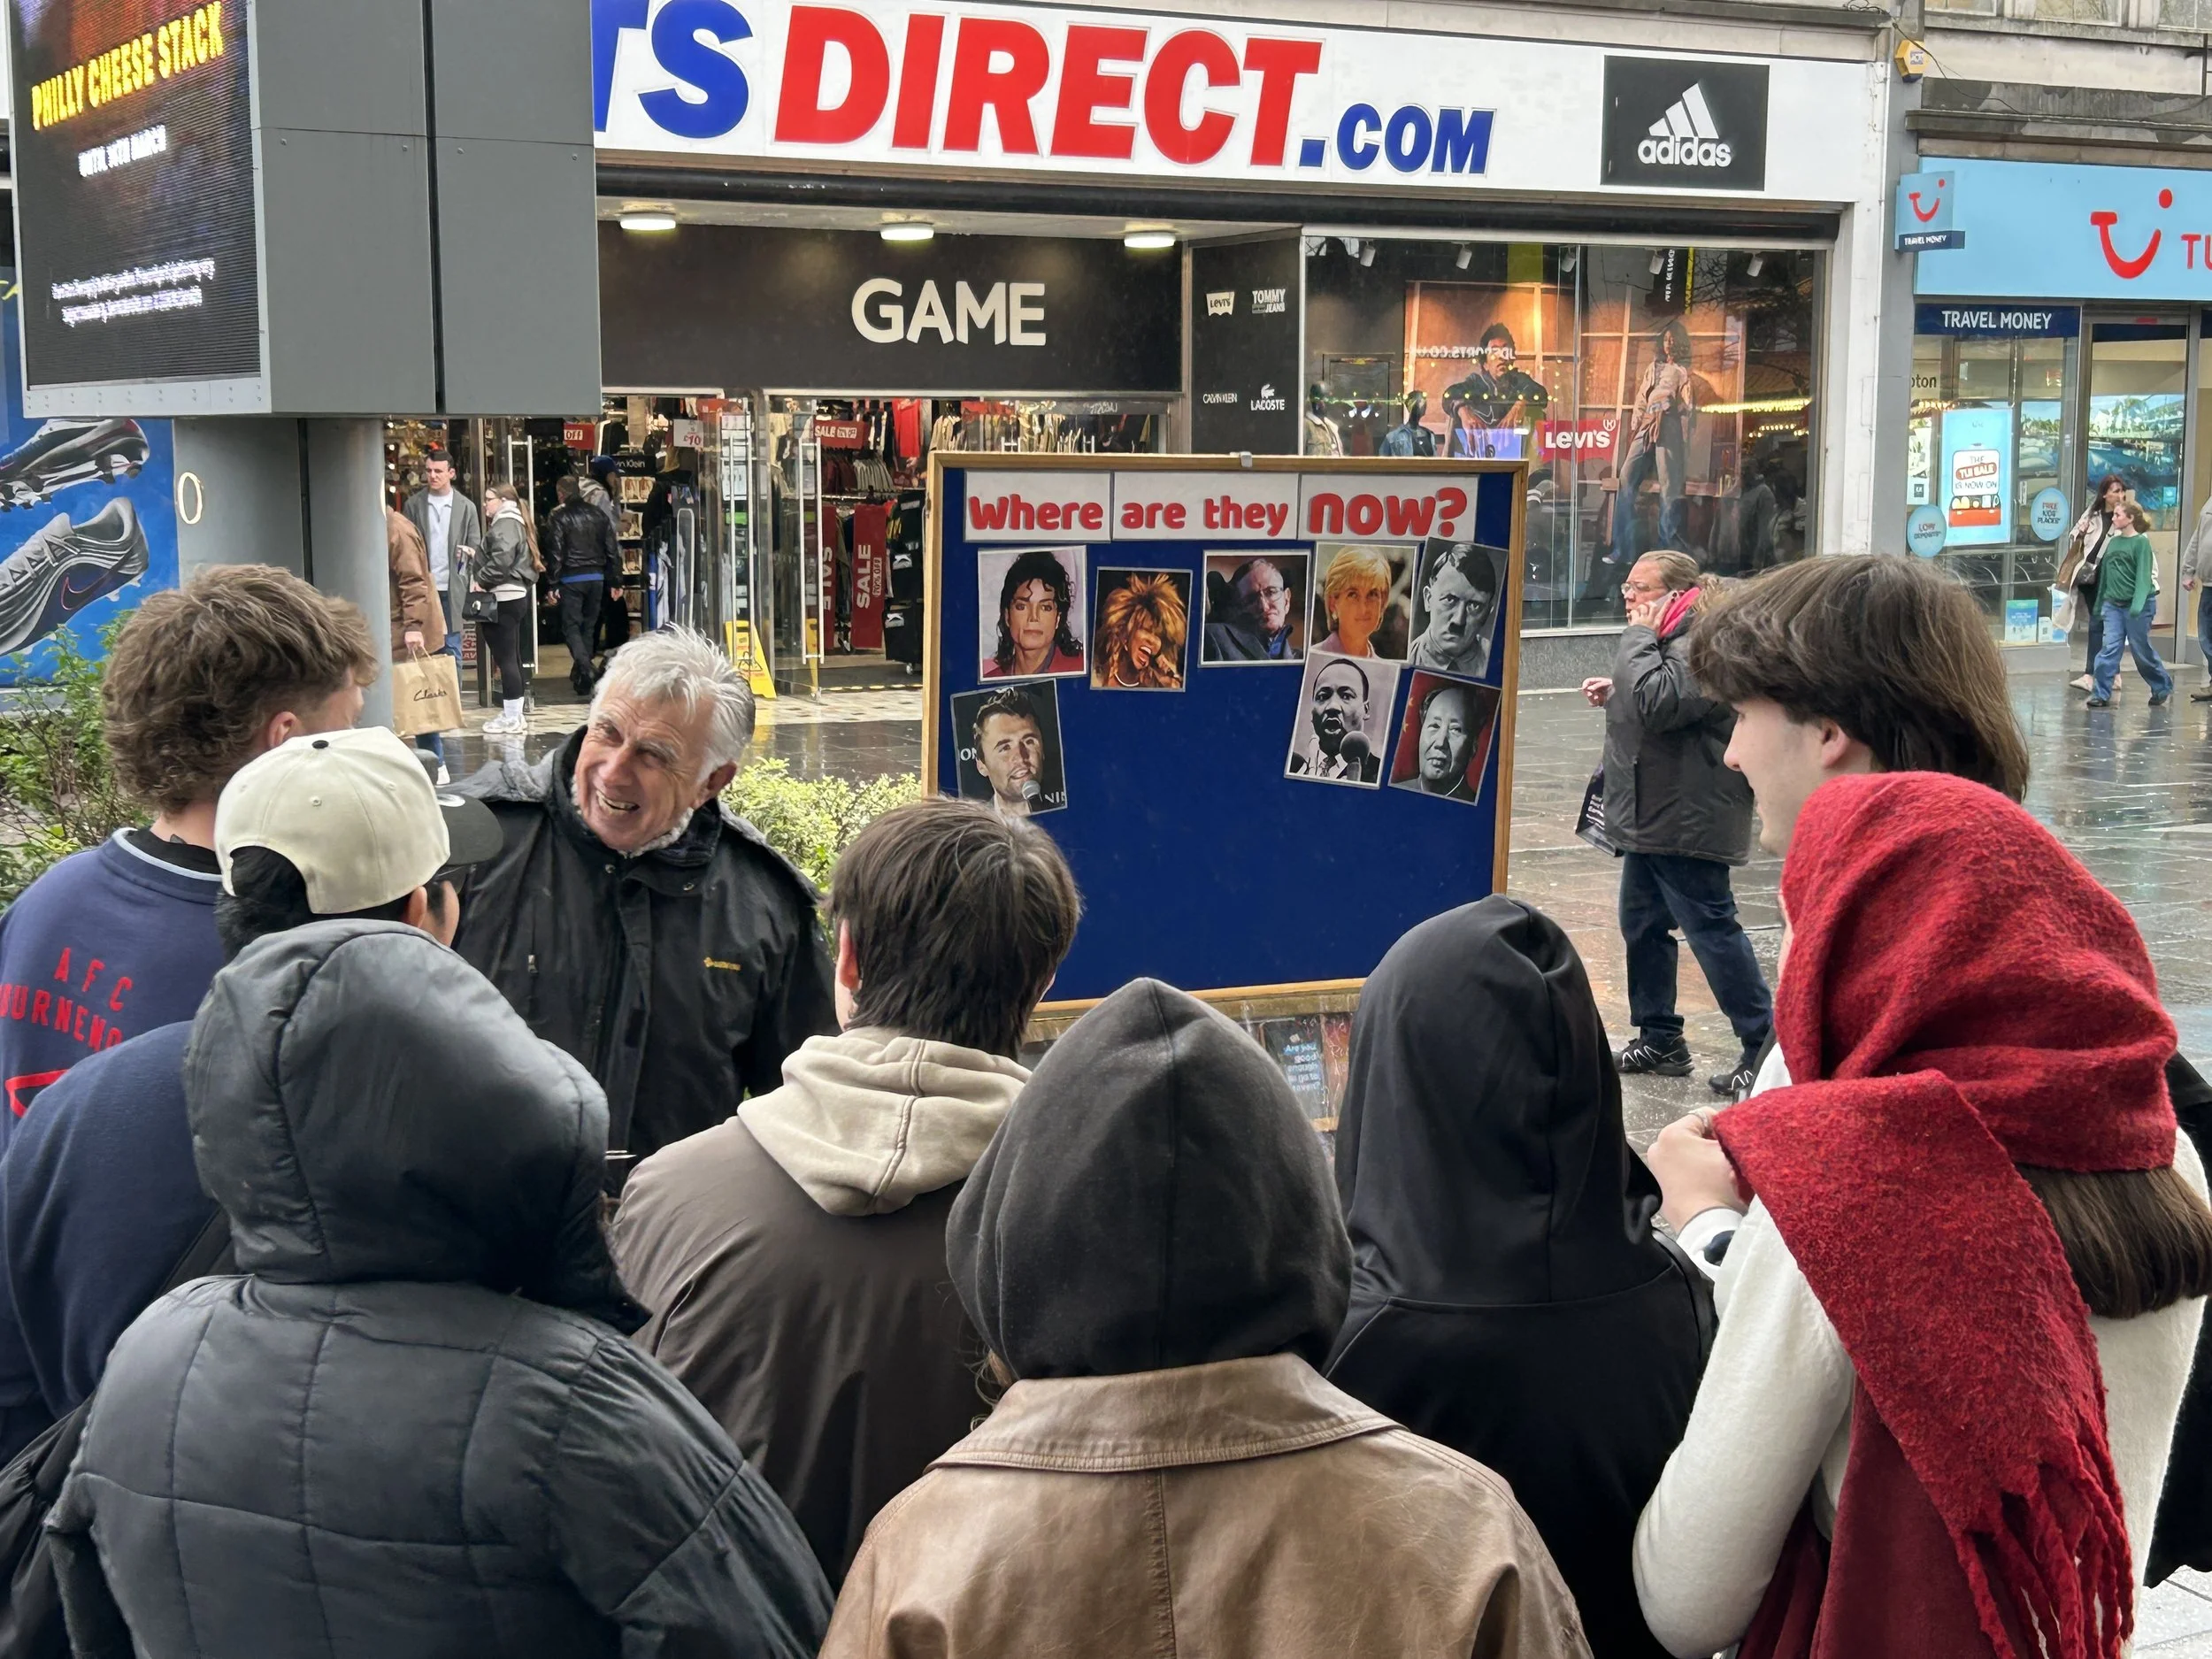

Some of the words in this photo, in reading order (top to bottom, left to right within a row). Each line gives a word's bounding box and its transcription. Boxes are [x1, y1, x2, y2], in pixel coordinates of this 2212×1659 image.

[32, 65, 84, 130] PHILLY
[88, 33, 154, 107] CHEESE
[157, 1, 224, 79] STACK
[1638, 136, 1732, 167] adidas
[1252, 288, 1286, 304] TOMMY
[851, 278, 1047, 346] GAME
[1941, 311, 1996, 328] TRAVEL
[2000, 312, 2052, 330] MONEY
[1251, 399, 1286, 411] LACOSTE
[814, 426, 836, 438] SALE
[970, 493, 1103, 531] Where
[1121, 501, 1187, 531] are
[1202, 495, 1288, 536] they
[1309, 488, 1467, 538] now?
[856, 544, 872, 610] SALE
